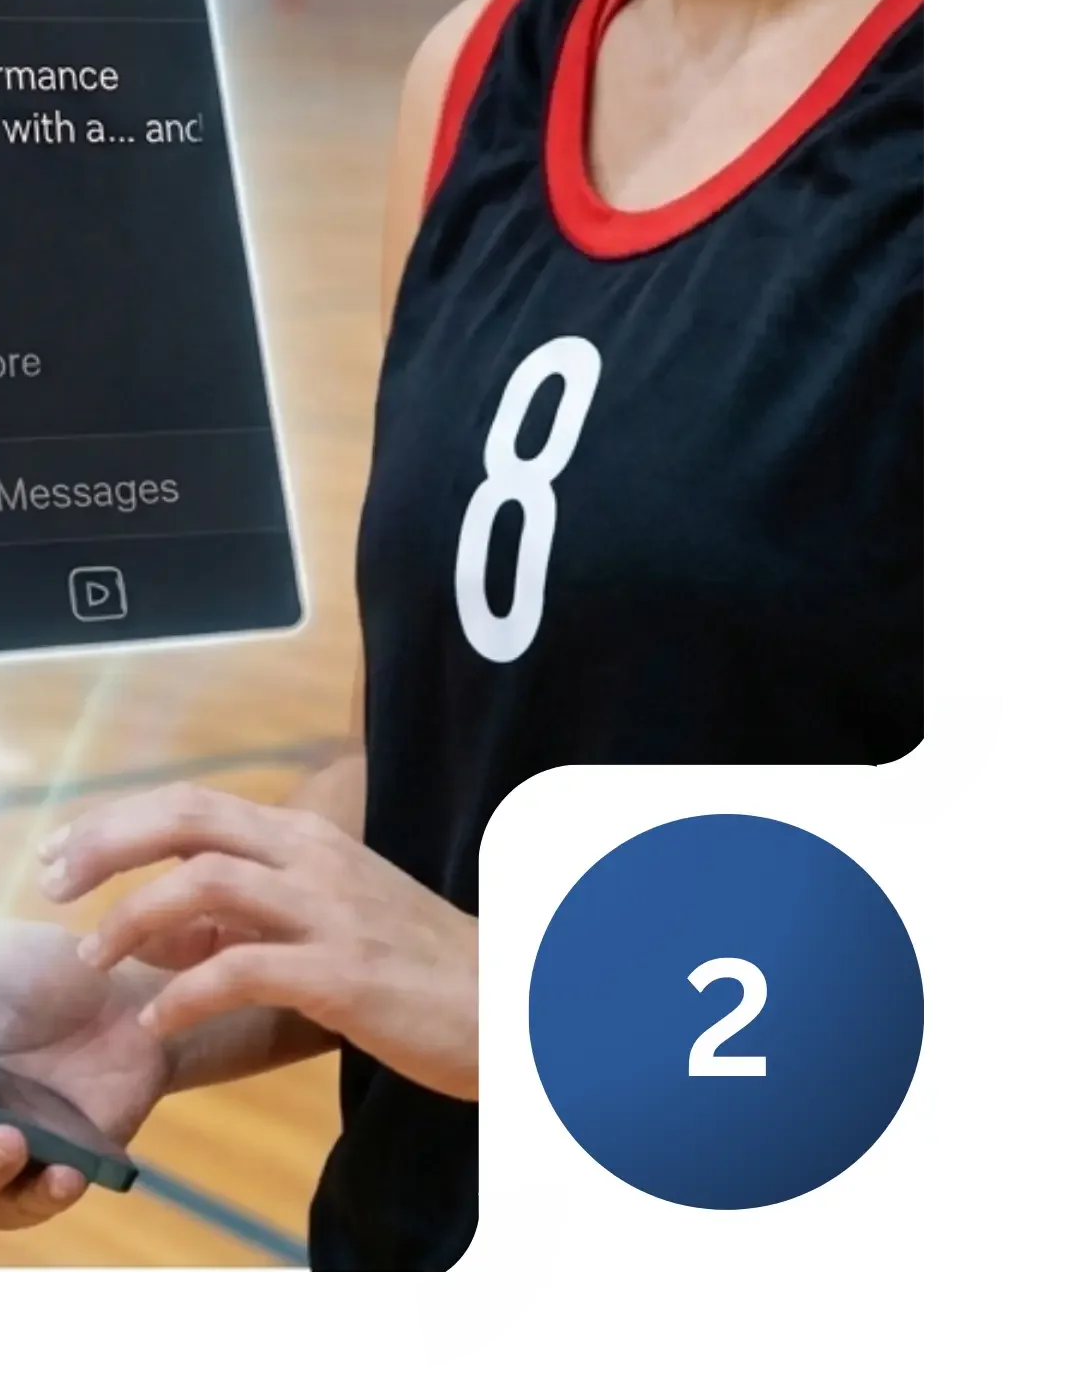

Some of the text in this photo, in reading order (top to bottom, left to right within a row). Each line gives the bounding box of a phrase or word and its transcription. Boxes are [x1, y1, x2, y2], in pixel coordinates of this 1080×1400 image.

[1, 110, 76, 144] with
[86, 119, 135, 143] a...
[454, 335, 603, 664] 8
